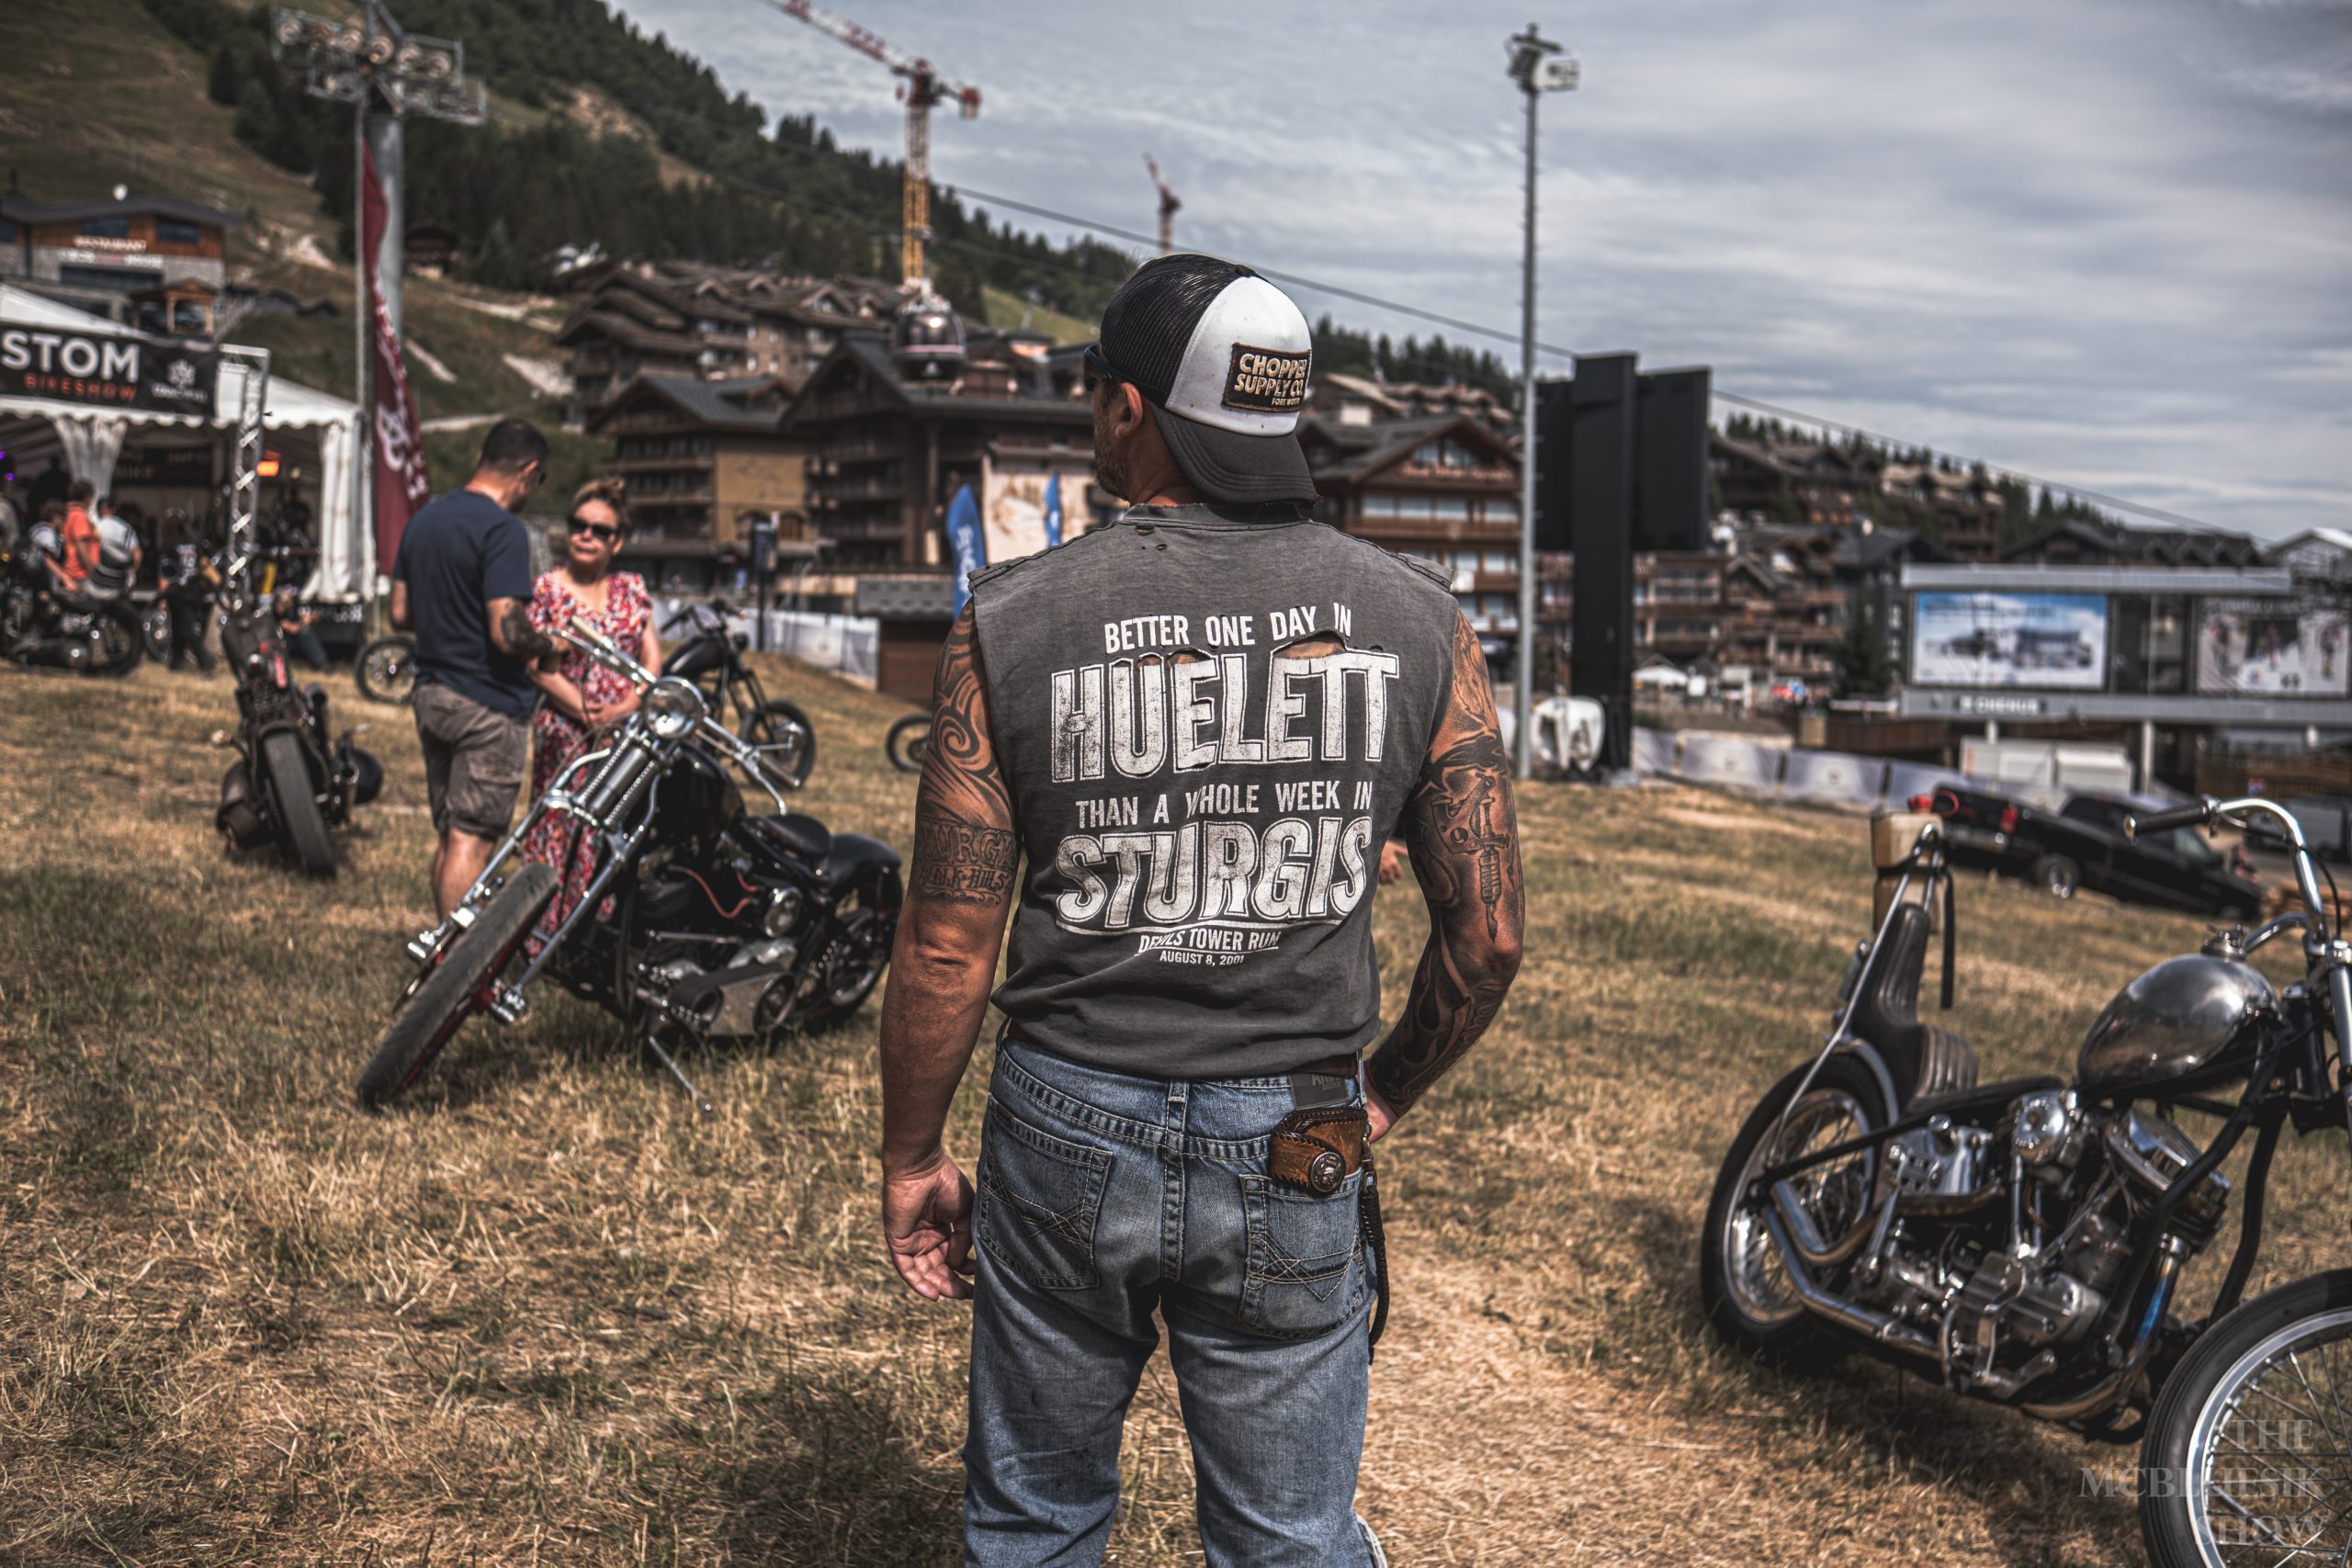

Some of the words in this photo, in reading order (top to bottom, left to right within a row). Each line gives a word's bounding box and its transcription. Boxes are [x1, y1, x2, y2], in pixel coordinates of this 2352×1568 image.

[24, 372, 137, 402] BIKESHOW
[1234, 373, 1291, 398] SUPPLY
[1104, 615, 1190, 654] BETTER
[1204, 615, 1253, 649] ONE
[1271, 605, 1317, 641] DAY
[1333, 603, 1352, 637] IN
[1051, 645, 1400, 784] HUELETT
[1076, 795, 1138, 829] THAN
[1154, 794, 1170, 825] A
[1185, 783, 1260, 819] WHOLE
[1275, 780, 1341, 812] WEEK
[1352, 781, 1373, 810] IN
[1057, 817, 1373, 930] STURGIS
[1137, 930, 1185, 954] DEVILS
[1189, 927, 1244, 952] TOWER
[1248, 931, 1282, 951] RUN
[1159, 950, 1204, 965] AUGUST
[1204, 954, 1216, 966] 8,
